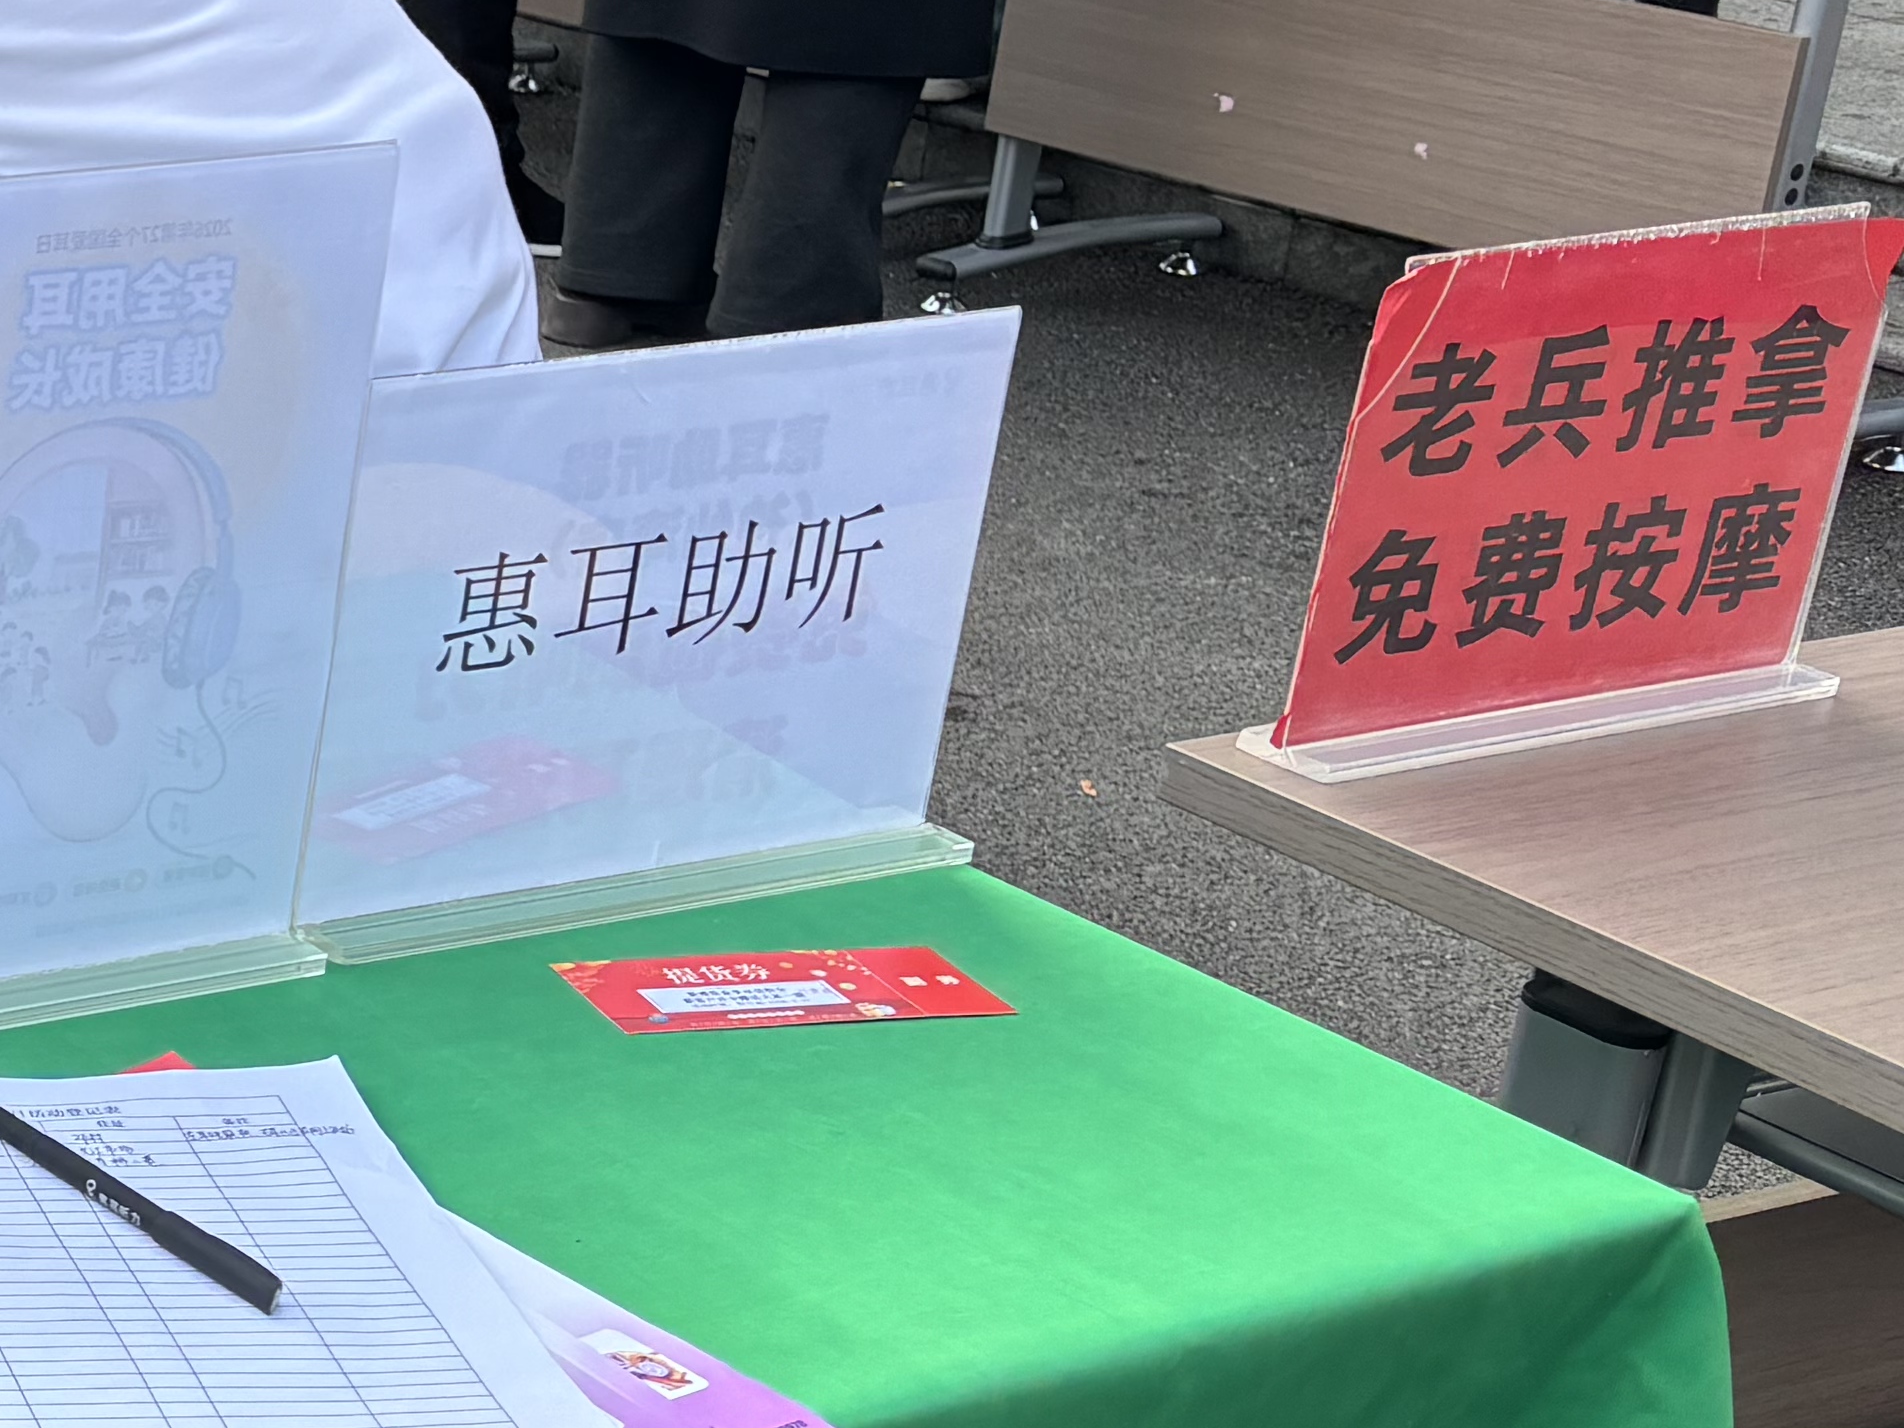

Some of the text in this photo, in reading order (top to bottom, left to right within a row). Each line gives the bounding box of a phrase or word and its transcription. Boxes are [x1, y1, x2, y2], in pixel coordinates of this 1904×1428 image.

[1380, 303, 1851, 477] 老兵推拿
[435, 503, 885, 673] 惠耳助听
[1332, 482, 1802, 666] 免费按摩
